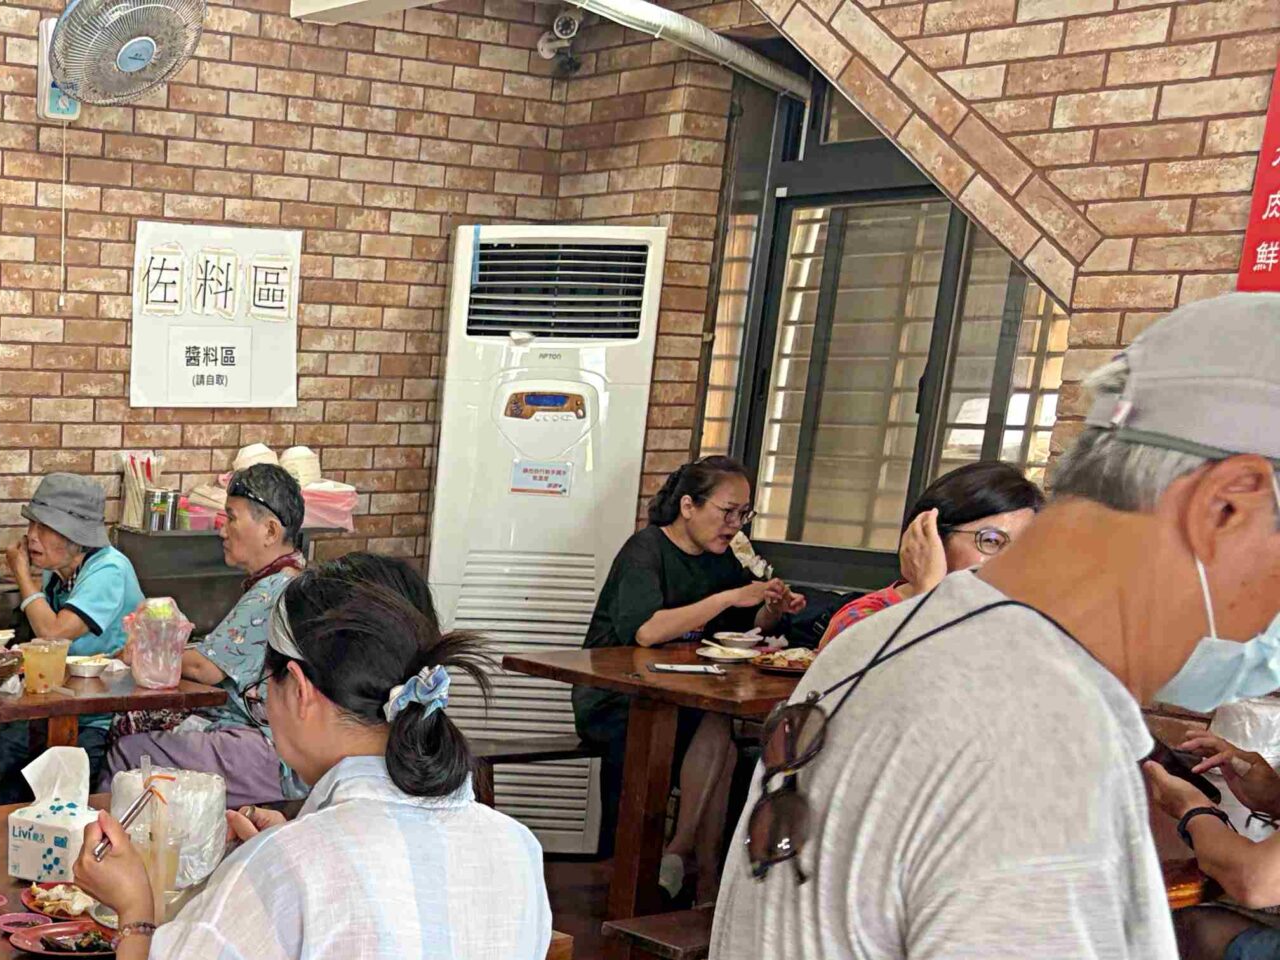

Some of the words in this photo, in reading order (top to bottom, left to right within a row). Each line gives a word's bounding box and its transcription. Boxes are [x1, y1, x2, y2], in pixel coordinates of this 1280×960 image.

[142, 256, 288, 309] 佐料區
[185, 345, 236, 366] 醬料區
[12, 824, 34, 839] Livi
